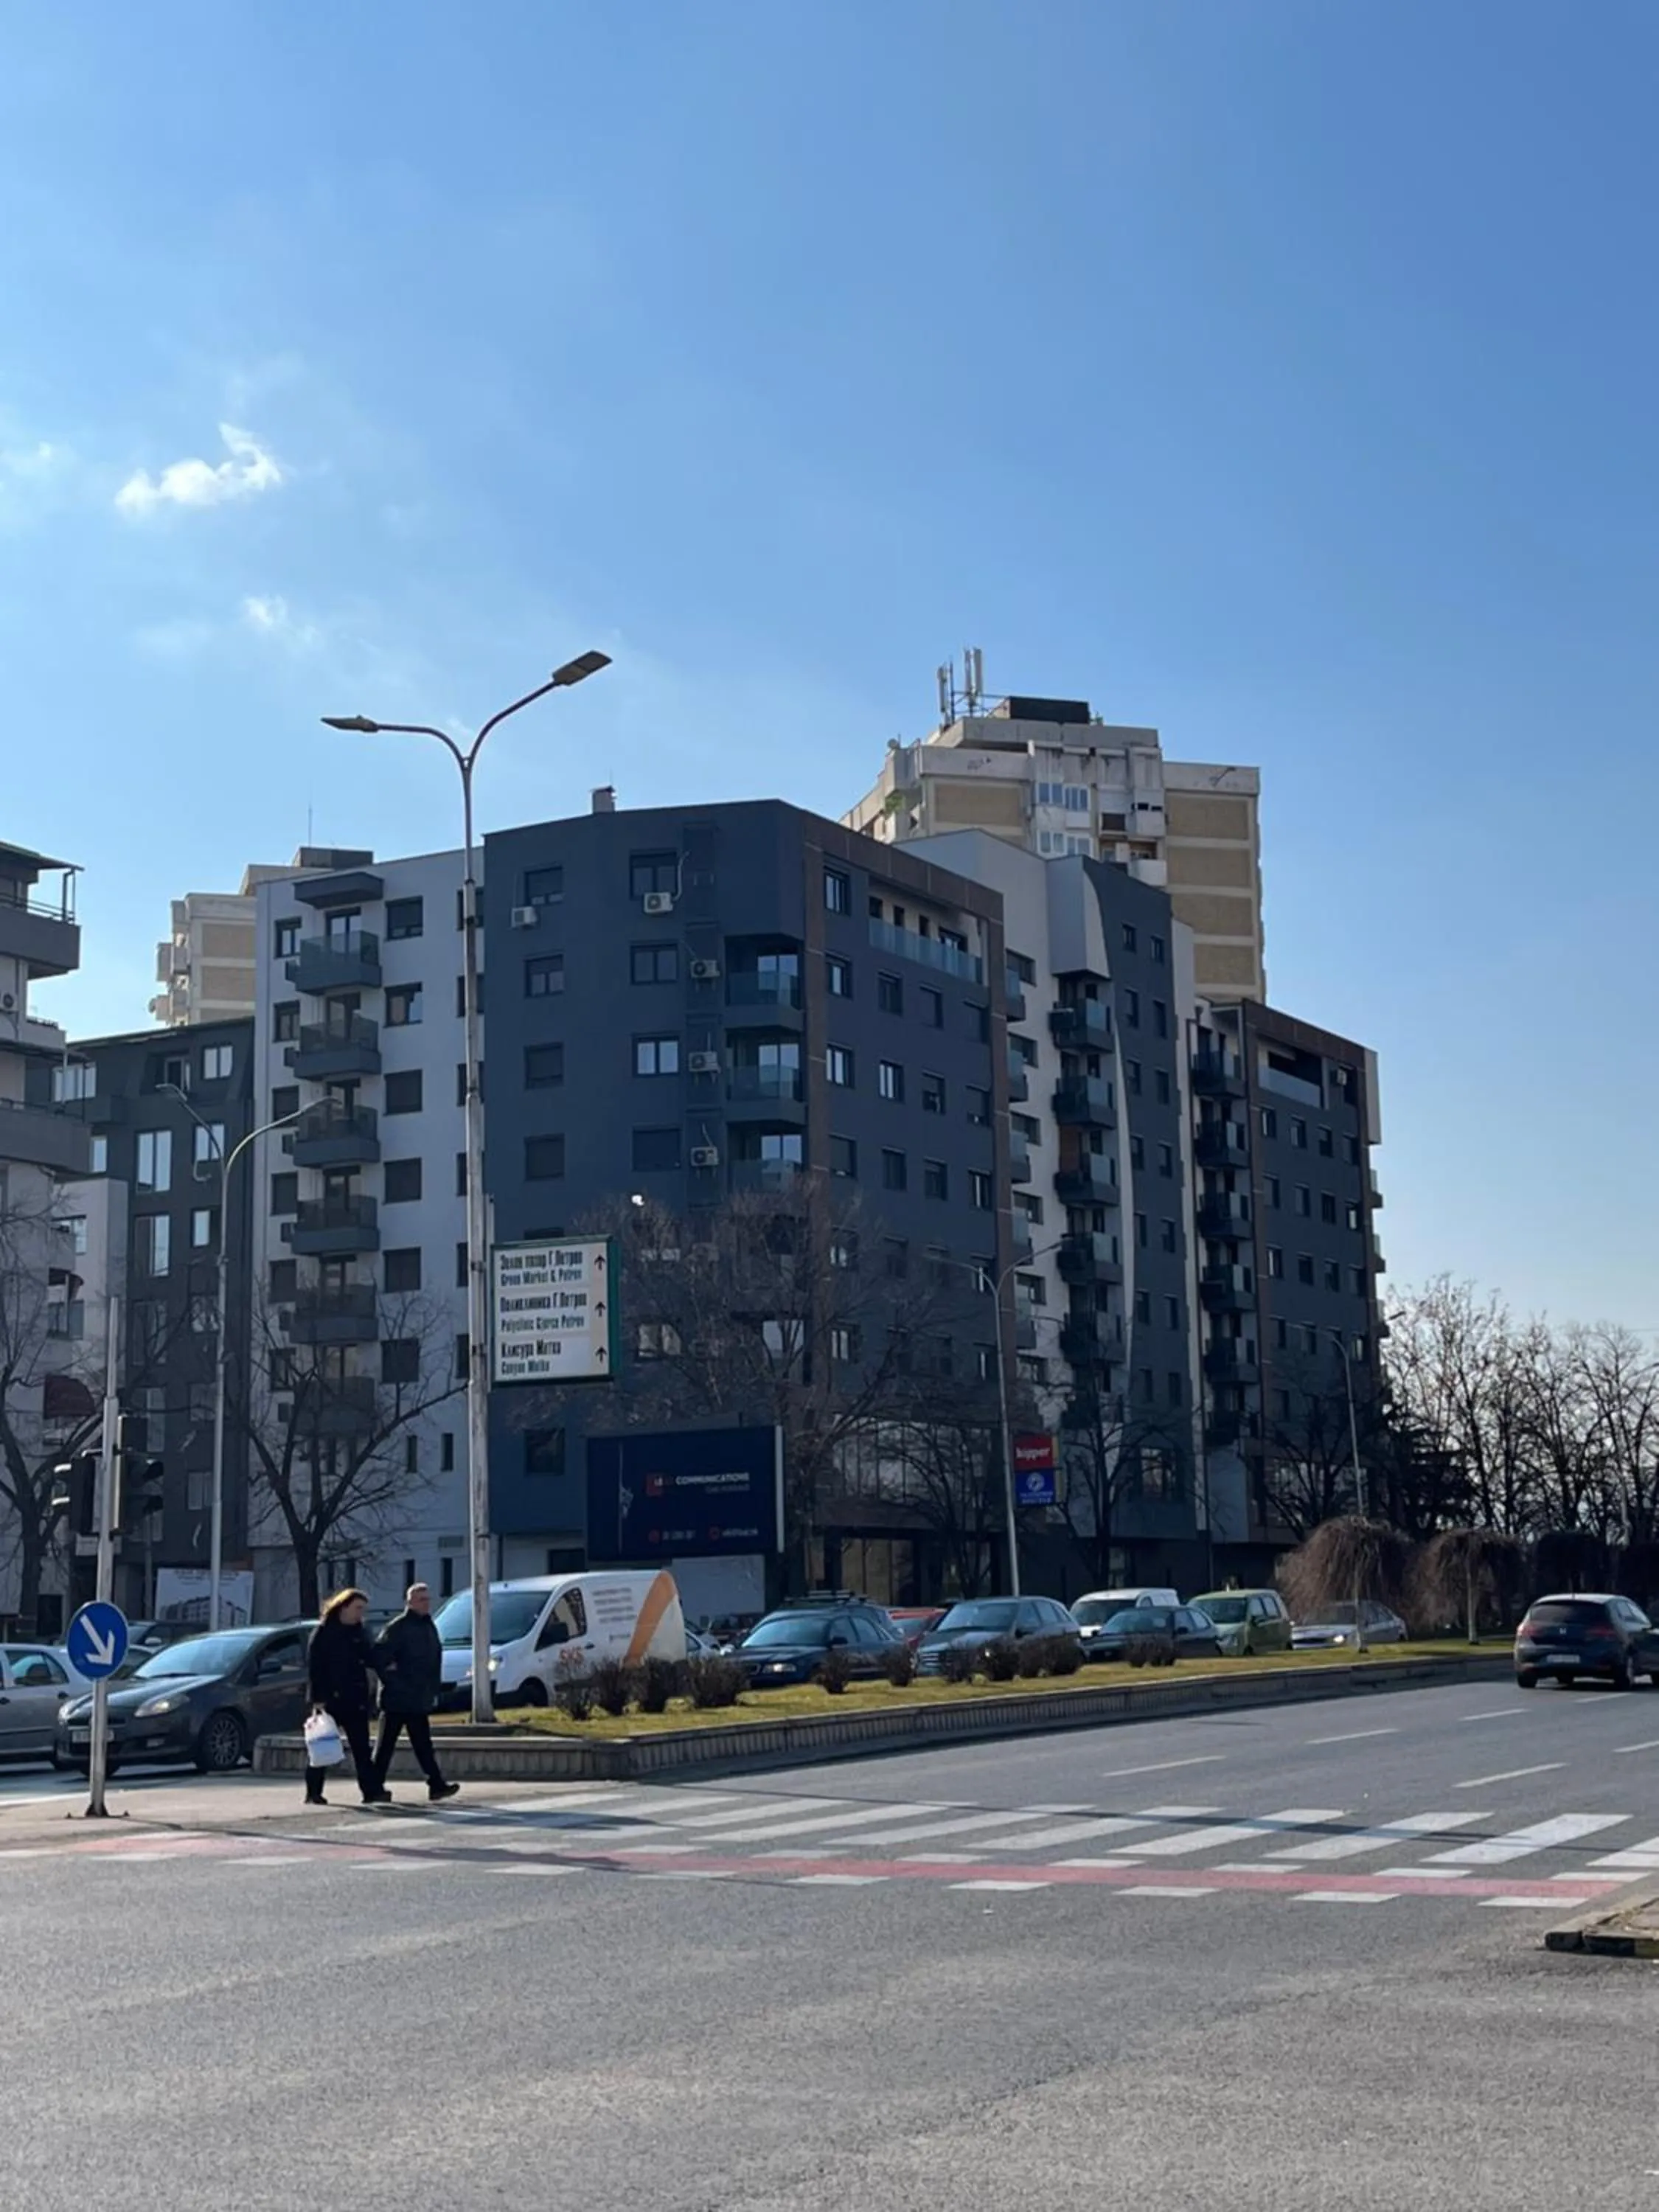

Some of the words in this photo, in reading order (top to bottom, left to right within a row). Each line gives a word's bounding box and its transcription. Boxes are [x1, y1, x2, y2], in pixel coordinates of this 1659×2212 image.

[501, 1273, 521, 1286] Green
[523, 1270, 548, 1284] Market
[559, 1267, 582, 1281] Petrov
[562, 1314, 585, 1328] Petrov
[537, 1339, 561, 1355] Матка
